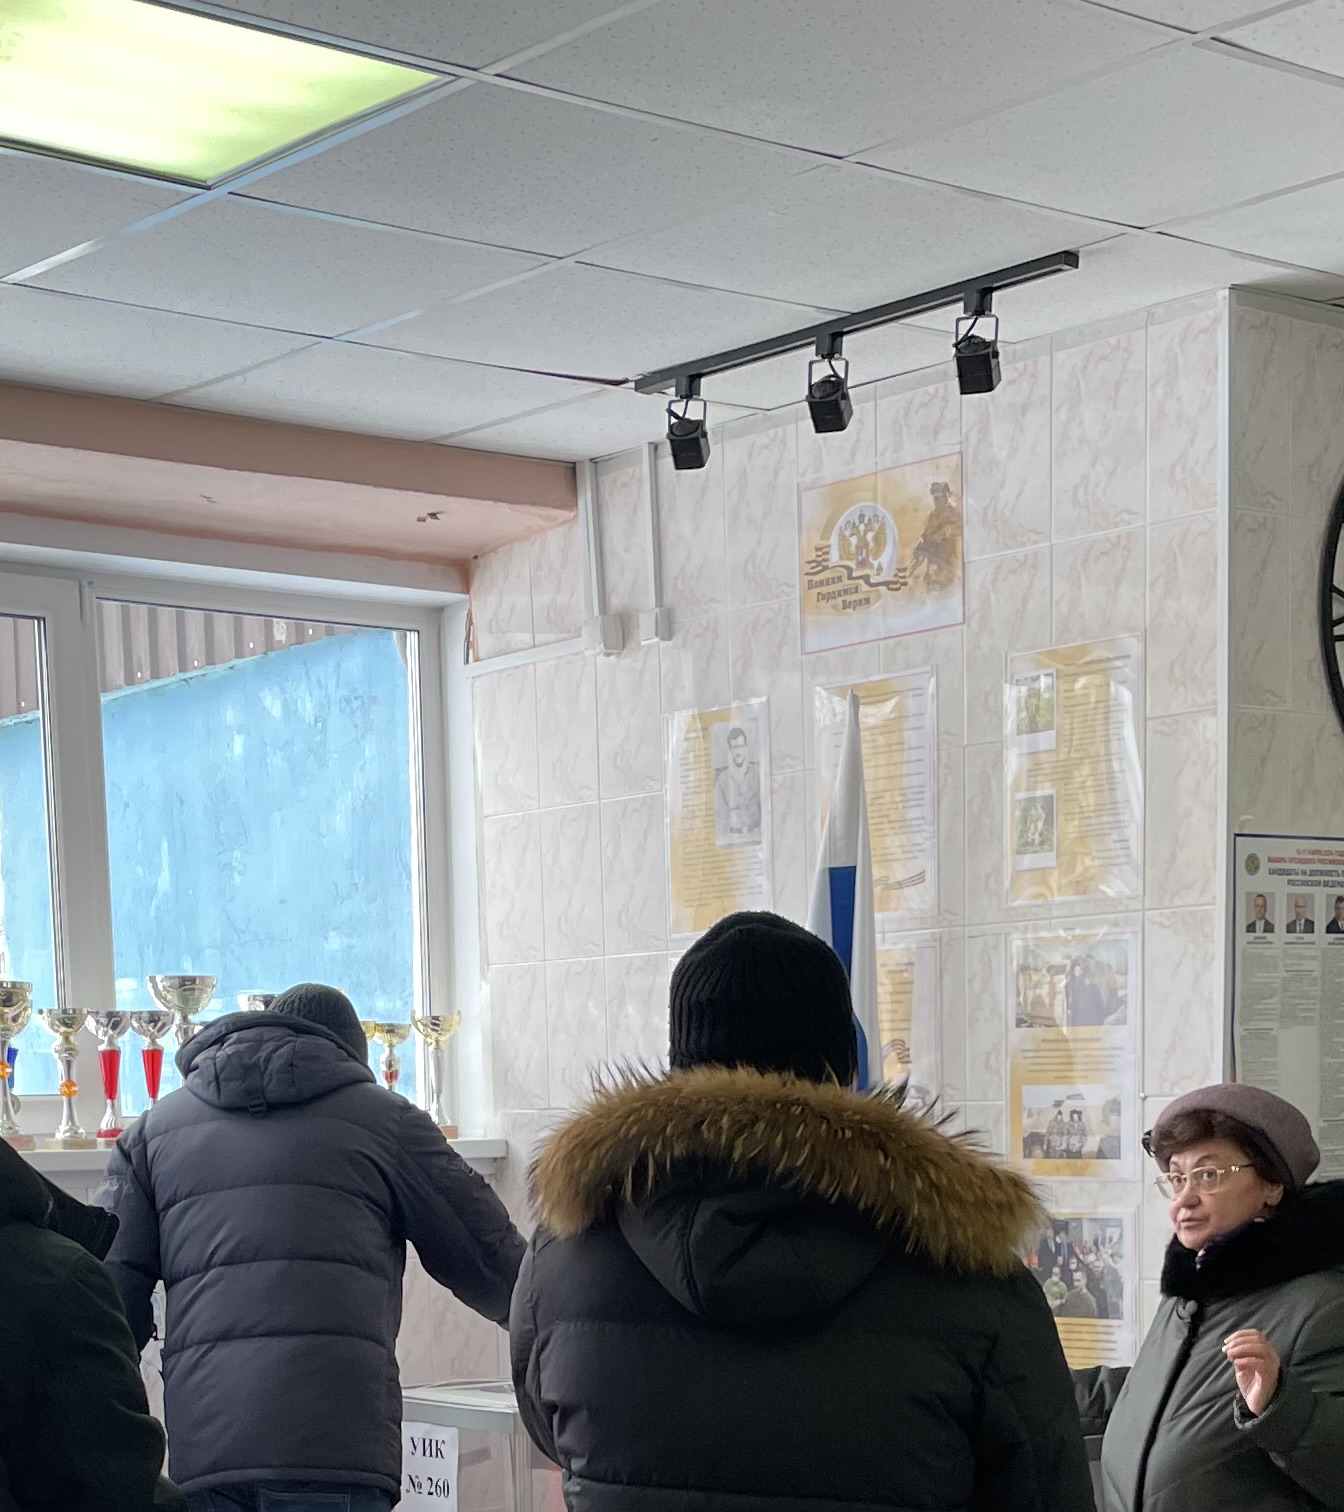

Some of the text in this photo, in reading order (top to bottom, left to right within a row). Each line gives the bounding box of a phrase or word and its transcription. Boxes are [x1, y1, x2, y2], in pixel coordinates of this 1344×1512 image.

[807, 575, 843, 590] Помним
[816, 585, 859, 603] Гордимся
[841, 596, 871, 611] Верим
[410, 1436, 446, 1460] УИК
[405, 1474, 450, 1499] № 260
